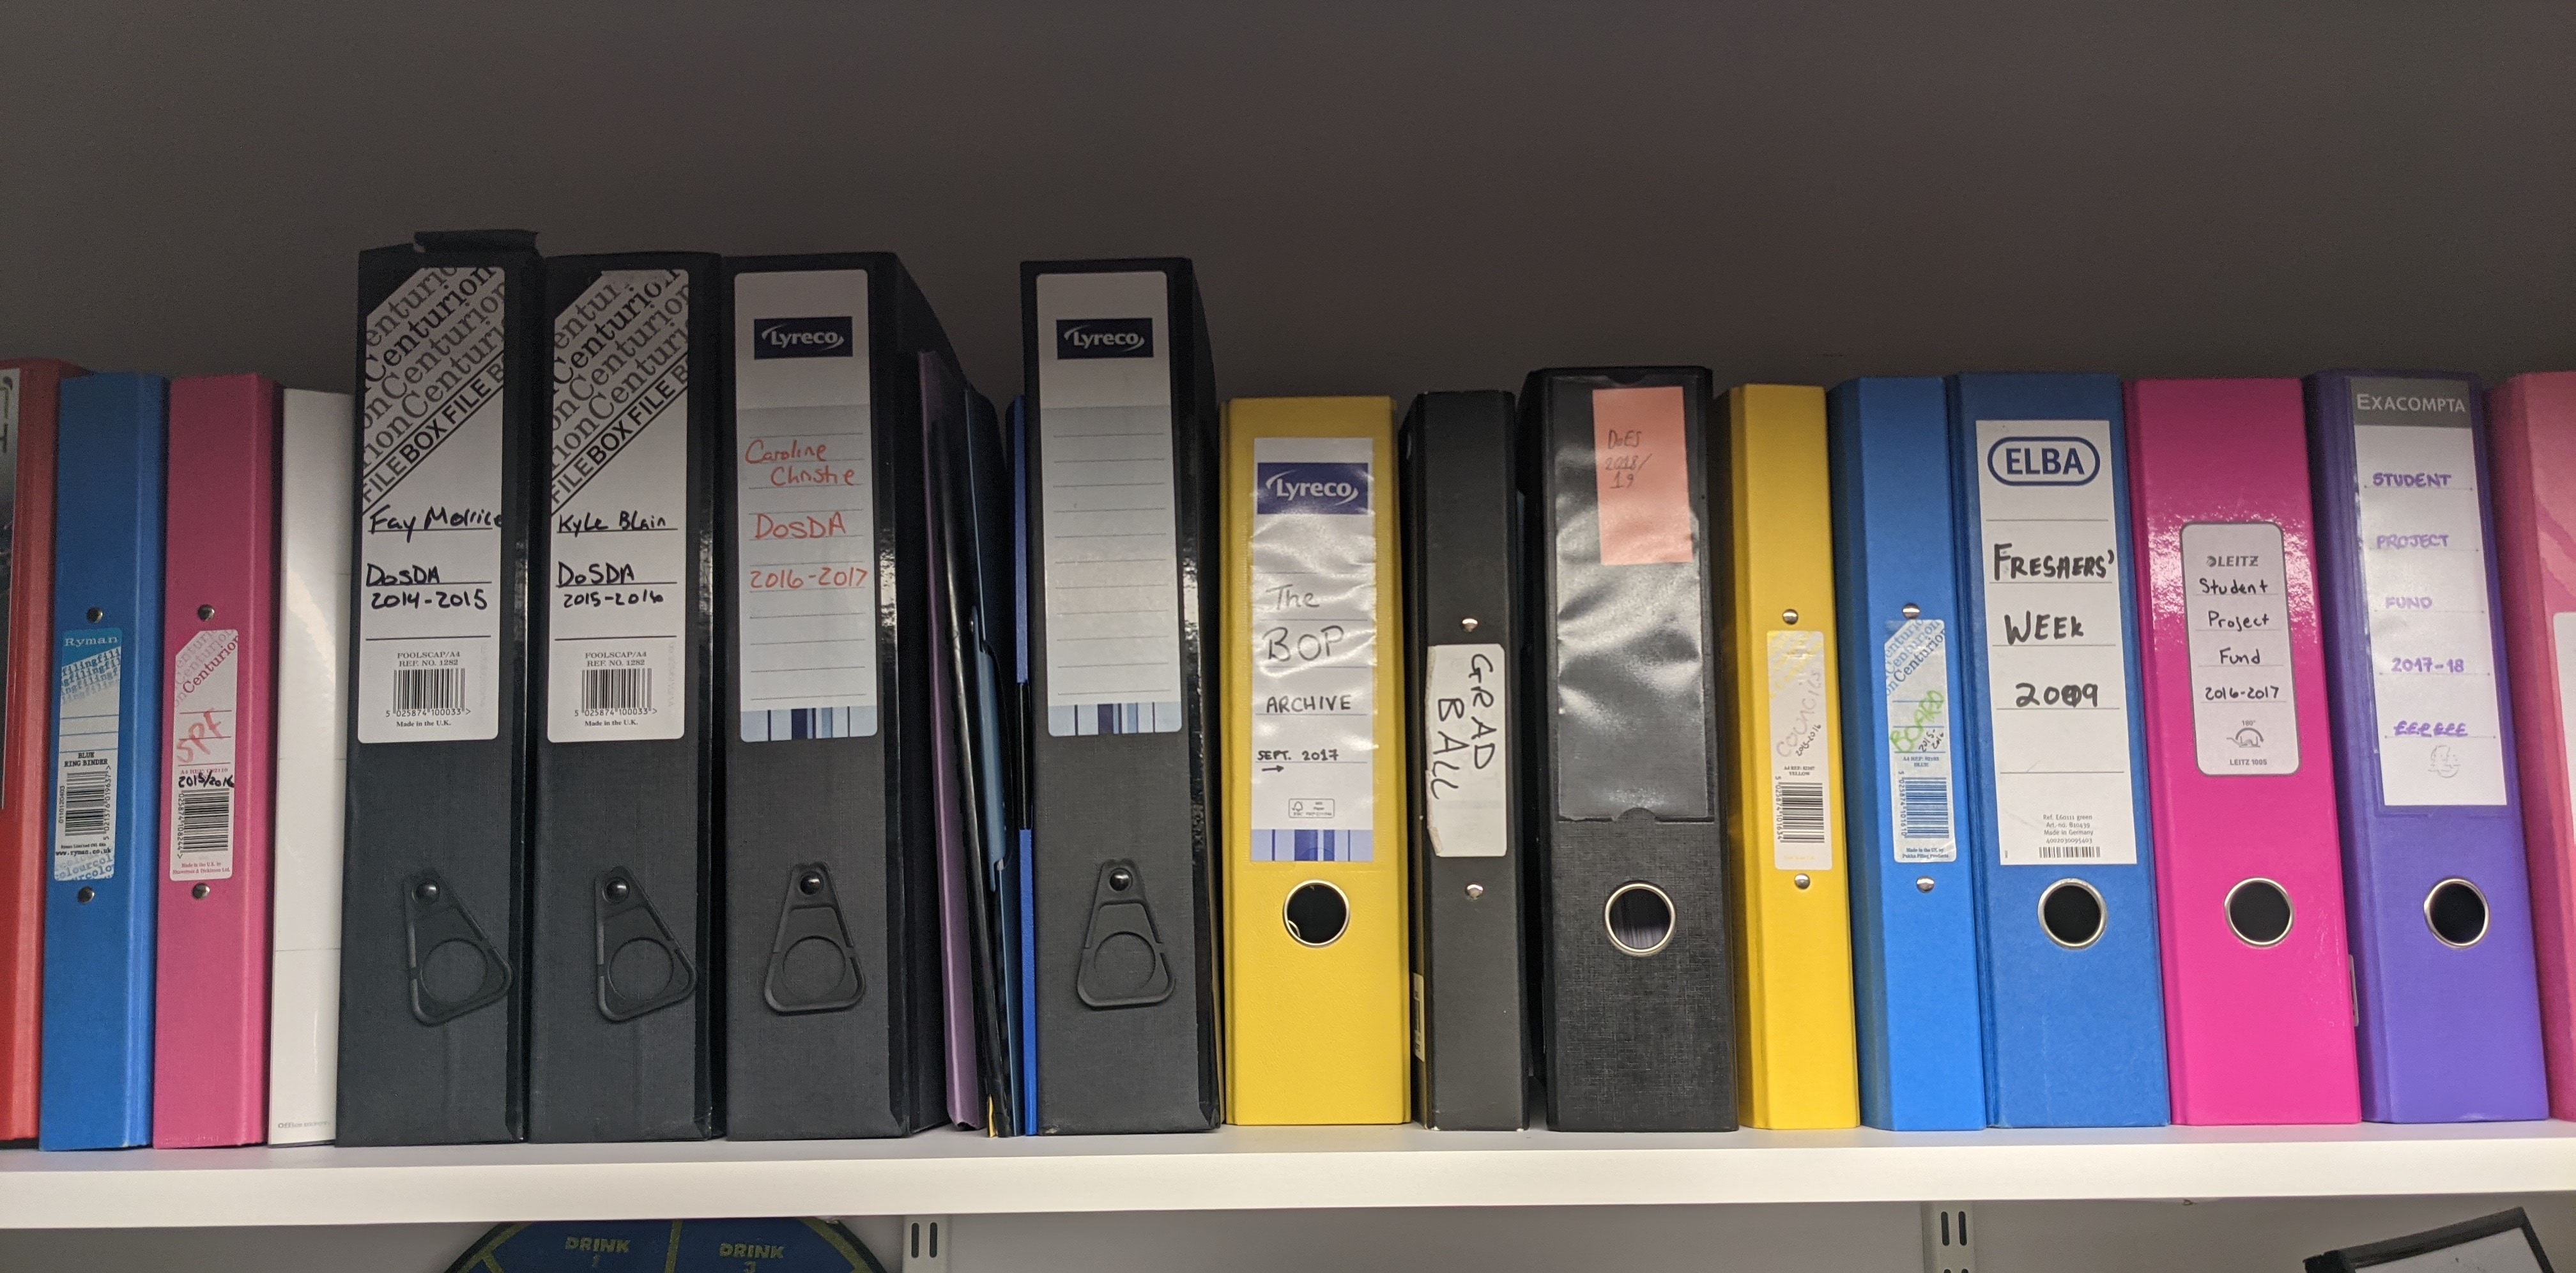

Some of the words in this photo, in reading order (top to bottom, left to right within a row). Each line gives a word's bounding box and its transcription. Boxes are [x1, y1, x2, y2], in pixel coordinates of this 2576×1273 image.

[771, 331, 838, 348] Lyreco
[1073, 332, 1138, 349] Lyreco
[2356, 393, 2466, 413] EXACOMPTA
[399, 418, 447, 464] BOX
[441, 378, 491, 425] FILE
[586, 419, 634, 466] BOX
[627, 379, 676, 426] FILE
[745, 439, 827, 464] Caroline
[2006, 448, 2085, 475] ELBA
[1276, 478, 1352, 501] Lyreco
[2373, 472, 2451, 488] STUDENT
[370, 504, 416, 543] Fay
[2376, 535, 2449, 549] PROJECT
[2218, 556, 2259, 567] LEITZ
[749, 567, 868, 589] 2016-2017
[2199, 577, 2268, 595] Student
[371, 588, 487, 609] 2014-2015
[564, 589, 664, 608] 2015-2016
[1266, 584, 1319, 611] The
[2385, 597, 2433, 610] FUND
[2208, 610, 2269, 632] Project
[65, 636, 118, 648] Ryman
[1262, 625, 1344, 662] BOP
[2220, 647, 2260, 664] Fund
[2205, 685, 2279, 700] 2016-2017
[396, 709, 427, 717] 025874
[1266, 694, 1351, 713] ARCHIVE
[1469, 653, 1497, 769] GRAD
[1257, 750, 1291, 761] SEPT.
[1301, 749, 1339, 761] 2017
[1431, 698, 1469, 800] BALL
[565, 1237, 631, 1253] DRINK
[719, 1243, 784, 1259] DRINK
